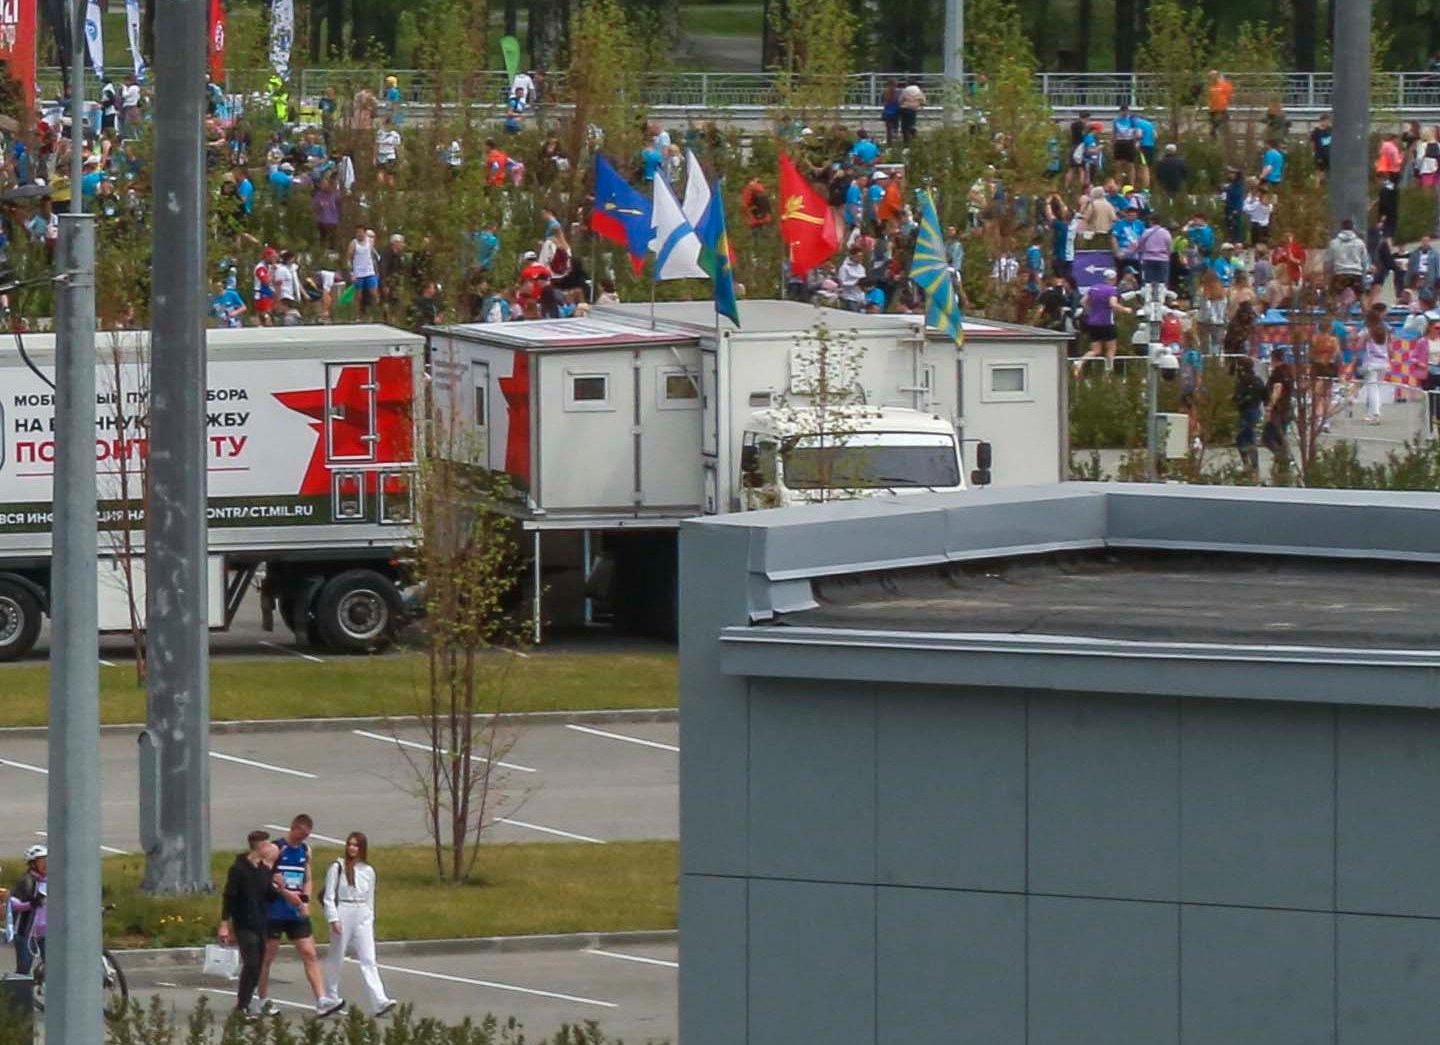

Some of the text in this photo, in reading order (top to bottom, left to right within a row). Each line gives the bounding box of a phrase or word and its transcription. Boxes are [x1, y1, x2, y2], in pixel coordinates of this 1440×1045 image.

[206, 389, 249, 402] БОРА
[15, 418, 44, 432] НА
[206, 411, 250, 427] ЖБУ
[206, 504, 314, 519] ONTRACT.MIL.RU
